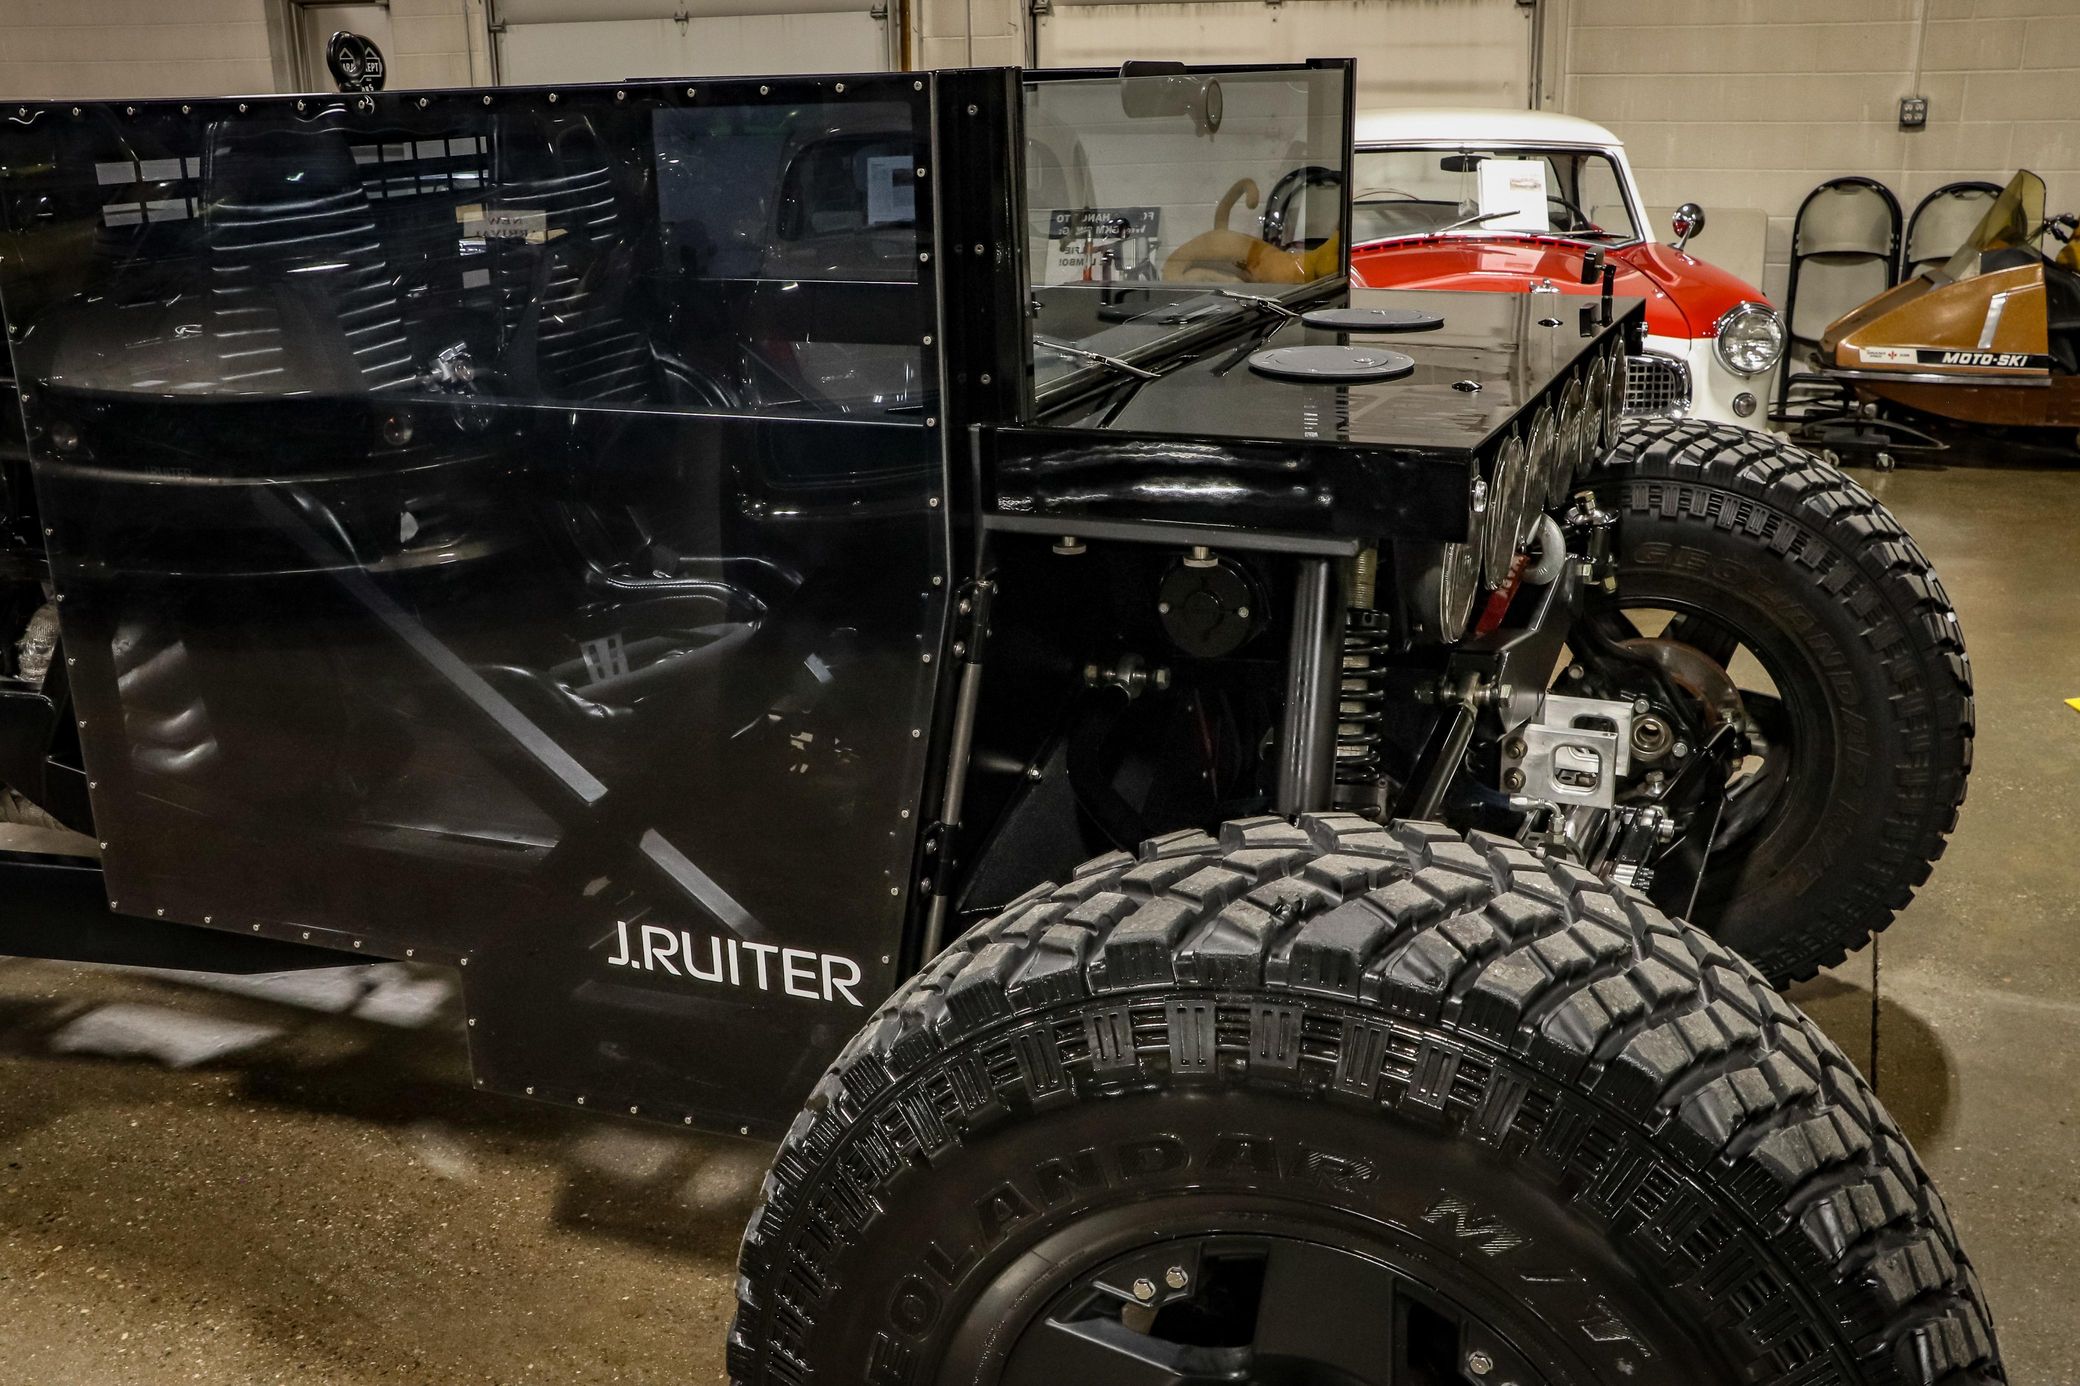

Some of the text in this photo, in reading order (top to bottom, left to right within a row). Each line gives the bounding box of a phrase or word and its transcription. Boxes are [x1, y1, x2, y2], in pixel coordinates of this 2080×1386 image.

[1941, 352, 2029, 367] MOTO-SKI
[607, 920, 864, 1008] J.RUITER
[863, 1132, 1381, 1386] EOLANDAR
